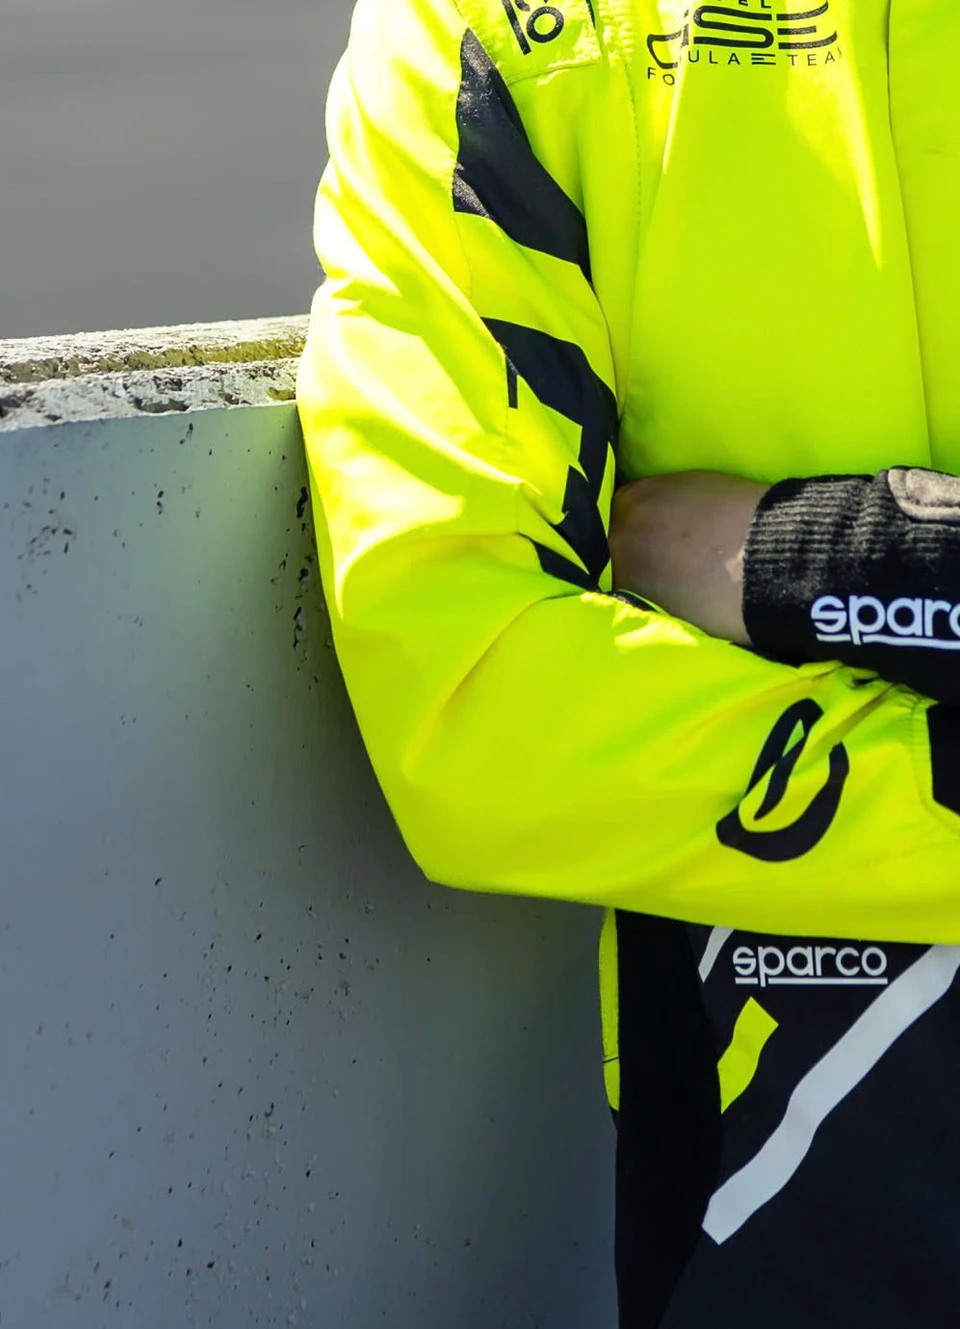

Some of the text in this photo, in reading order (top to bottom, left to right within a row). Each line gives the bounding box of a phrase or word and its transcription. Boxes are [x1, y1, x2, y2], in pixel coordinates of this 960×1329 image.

[647, 49, 741, 86] FOULA
[786, 46, 843, 67] TEA
[732, 945, 888, 988] sparco
